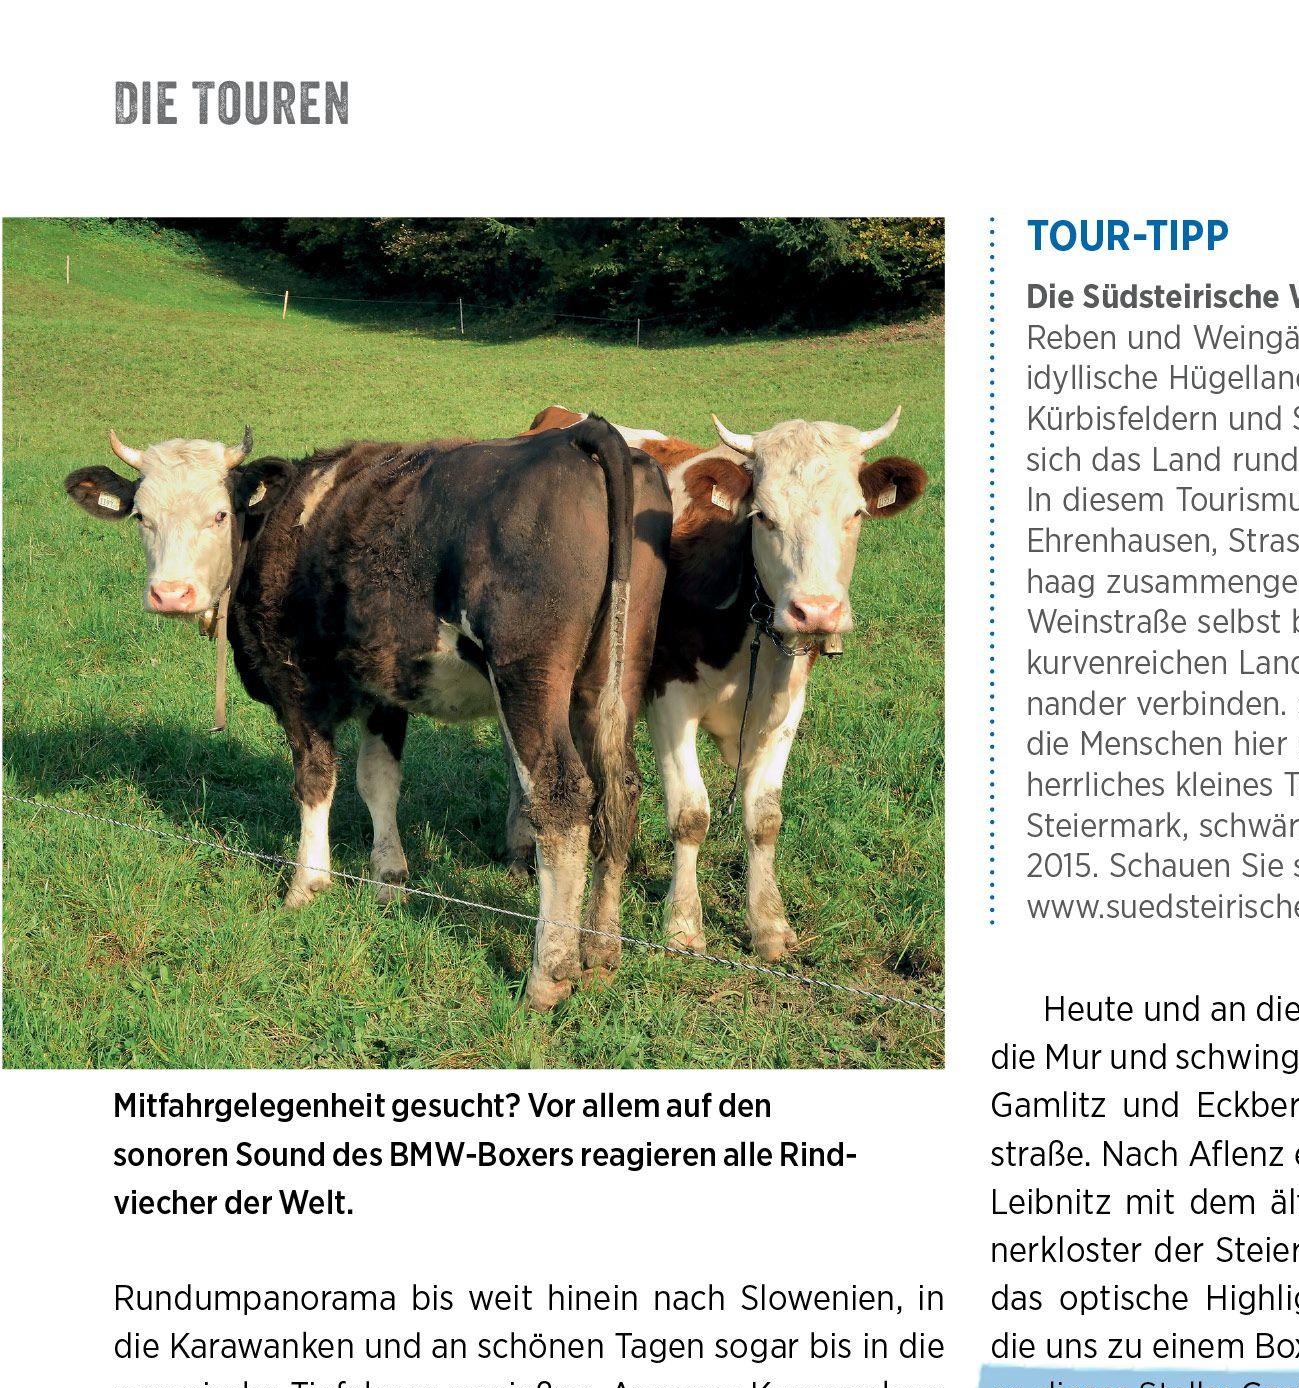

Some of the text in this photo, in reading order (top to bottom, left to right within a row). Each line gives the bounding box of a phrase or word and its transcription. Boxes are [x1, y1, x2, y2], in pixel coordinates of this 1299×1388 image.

[115, 80, 349, 126] DIE TOUREN
[1027, 219, 1229, 252] TOUR-TIPP
[1027, 283, 1074, 309] Die
[1083, 283, 1279, 309] Südsteirische
[1028, 324, 1116, 350] Reben
[1128, 324, 1180, 350] und
[1028, 486, 1051, 512] In
[1063, 486, 1163, 512] diesem
[1028, 648, 1227, 675] kurvenreichen
[1045, 995, 1134, 1022] Heute
[1144, 994, 1200, 1022] und
[1210, 1001, 1246, 1022] an
[114, 1092, 771, 1123] Mitfahrgelegenheit gesucht? Vor allem auf den
[113, 1141, 857, 1172] sonoren Sound des BMW-Boxers reagieren alle Rind-
[113, 1189, 353, 1215] viecher der Welt.
[115, 1283, 944, 1316] Rundumpanorama bis weit hinein nach Slowenien, in
[991, 1331, 1036, 1359] die
[1046, 1338, 1098, 1359] uns
[1107, 1338, 1142, 1359] zu
[1152, 1332, 1244, 1359] einem
